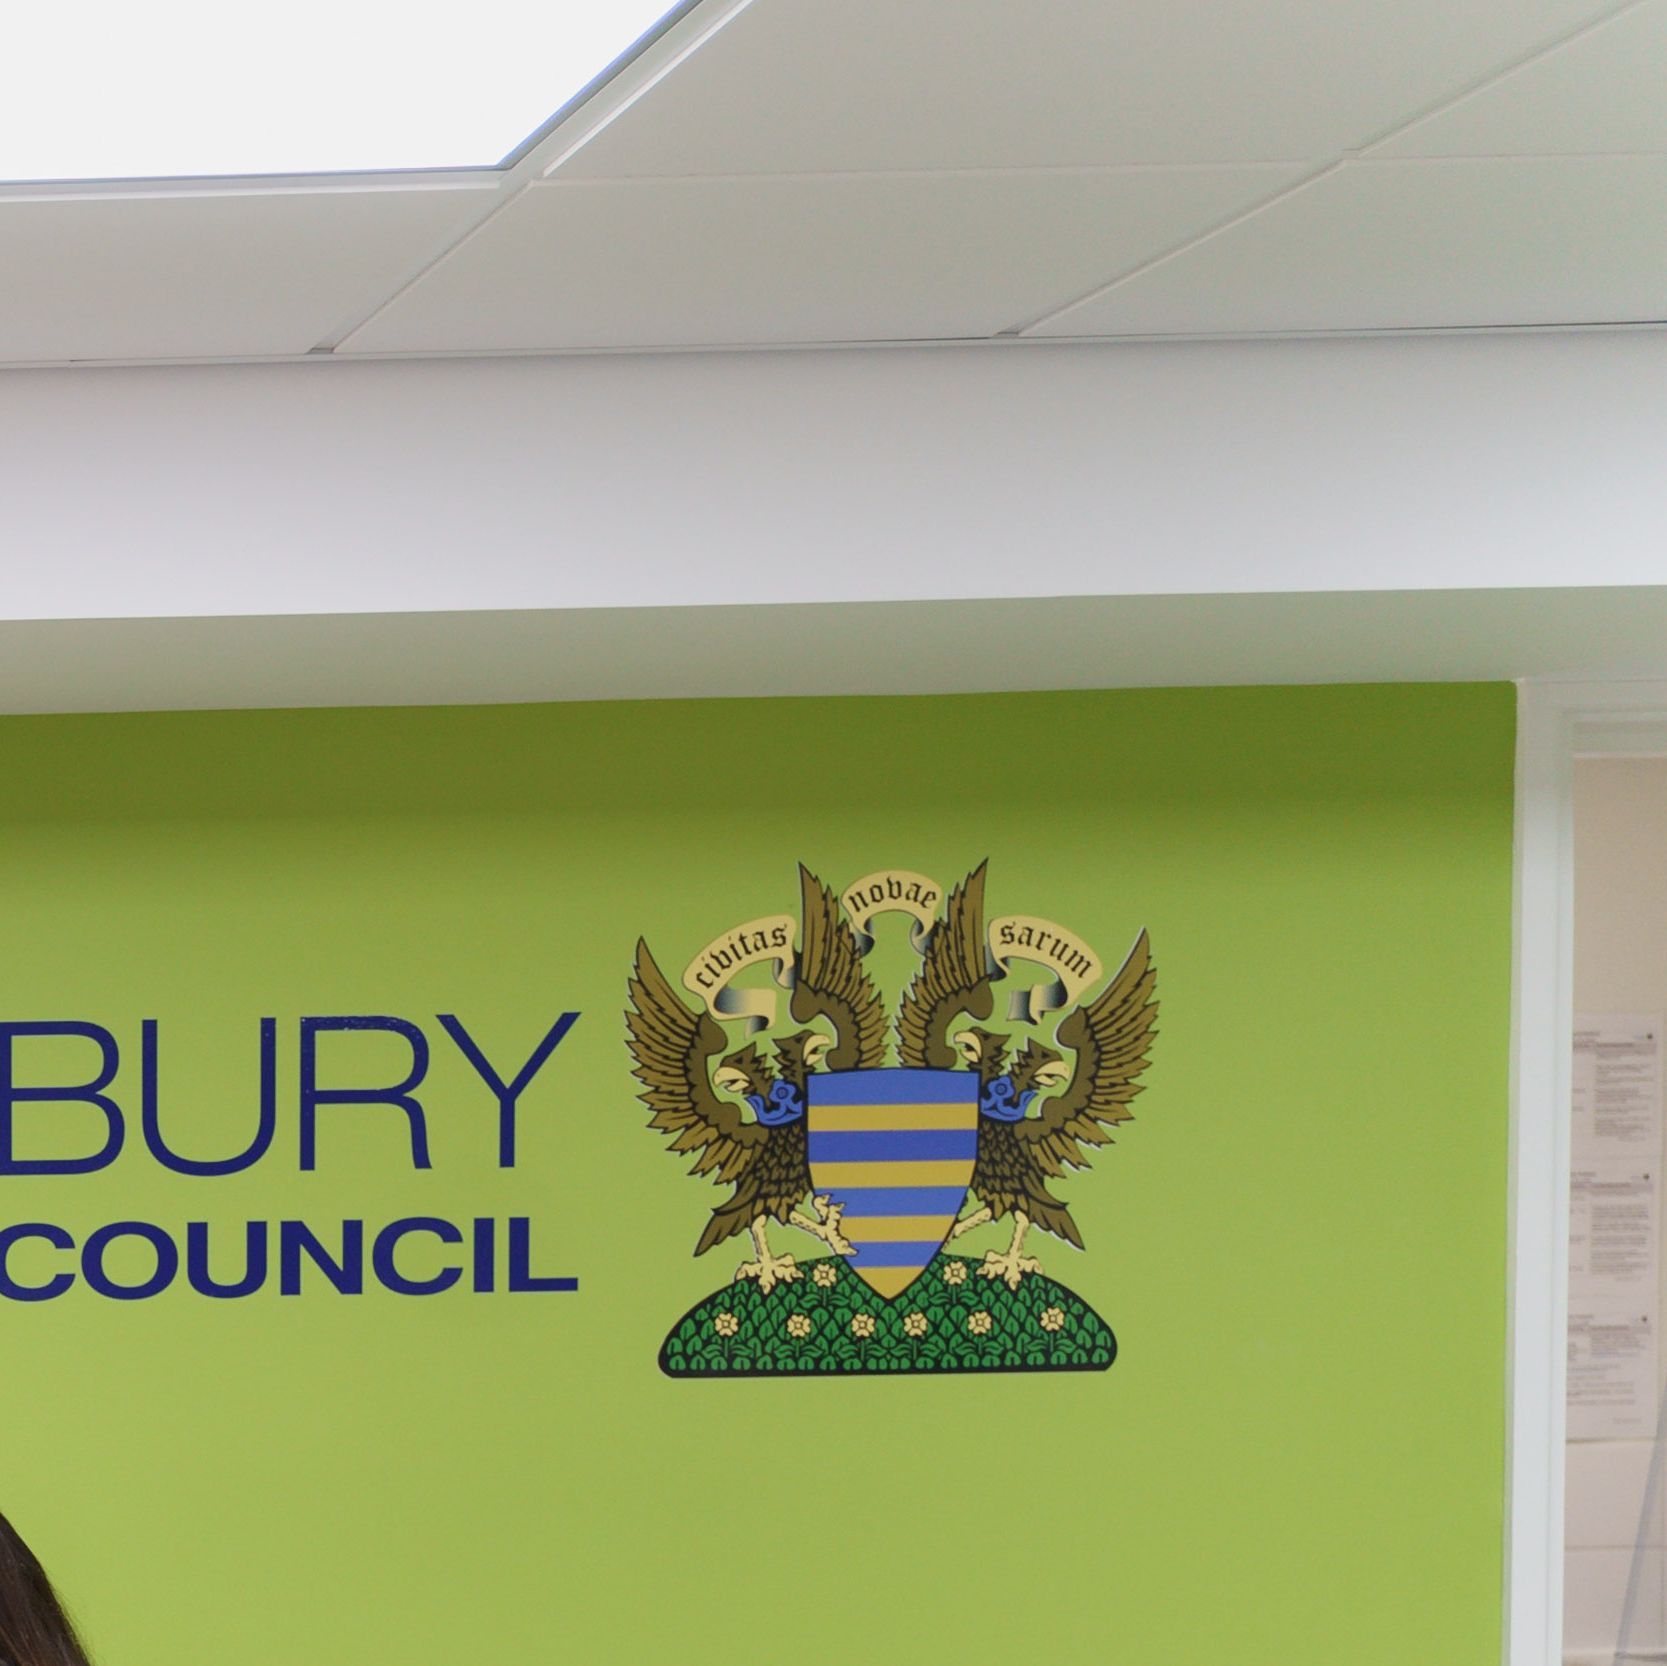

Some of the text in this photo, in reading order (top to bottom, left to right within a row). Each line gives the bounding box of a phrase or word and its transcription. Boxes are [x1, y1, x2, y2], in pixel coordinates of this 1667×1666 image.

[694, 875, 1094, 990] civitas novae sarum
